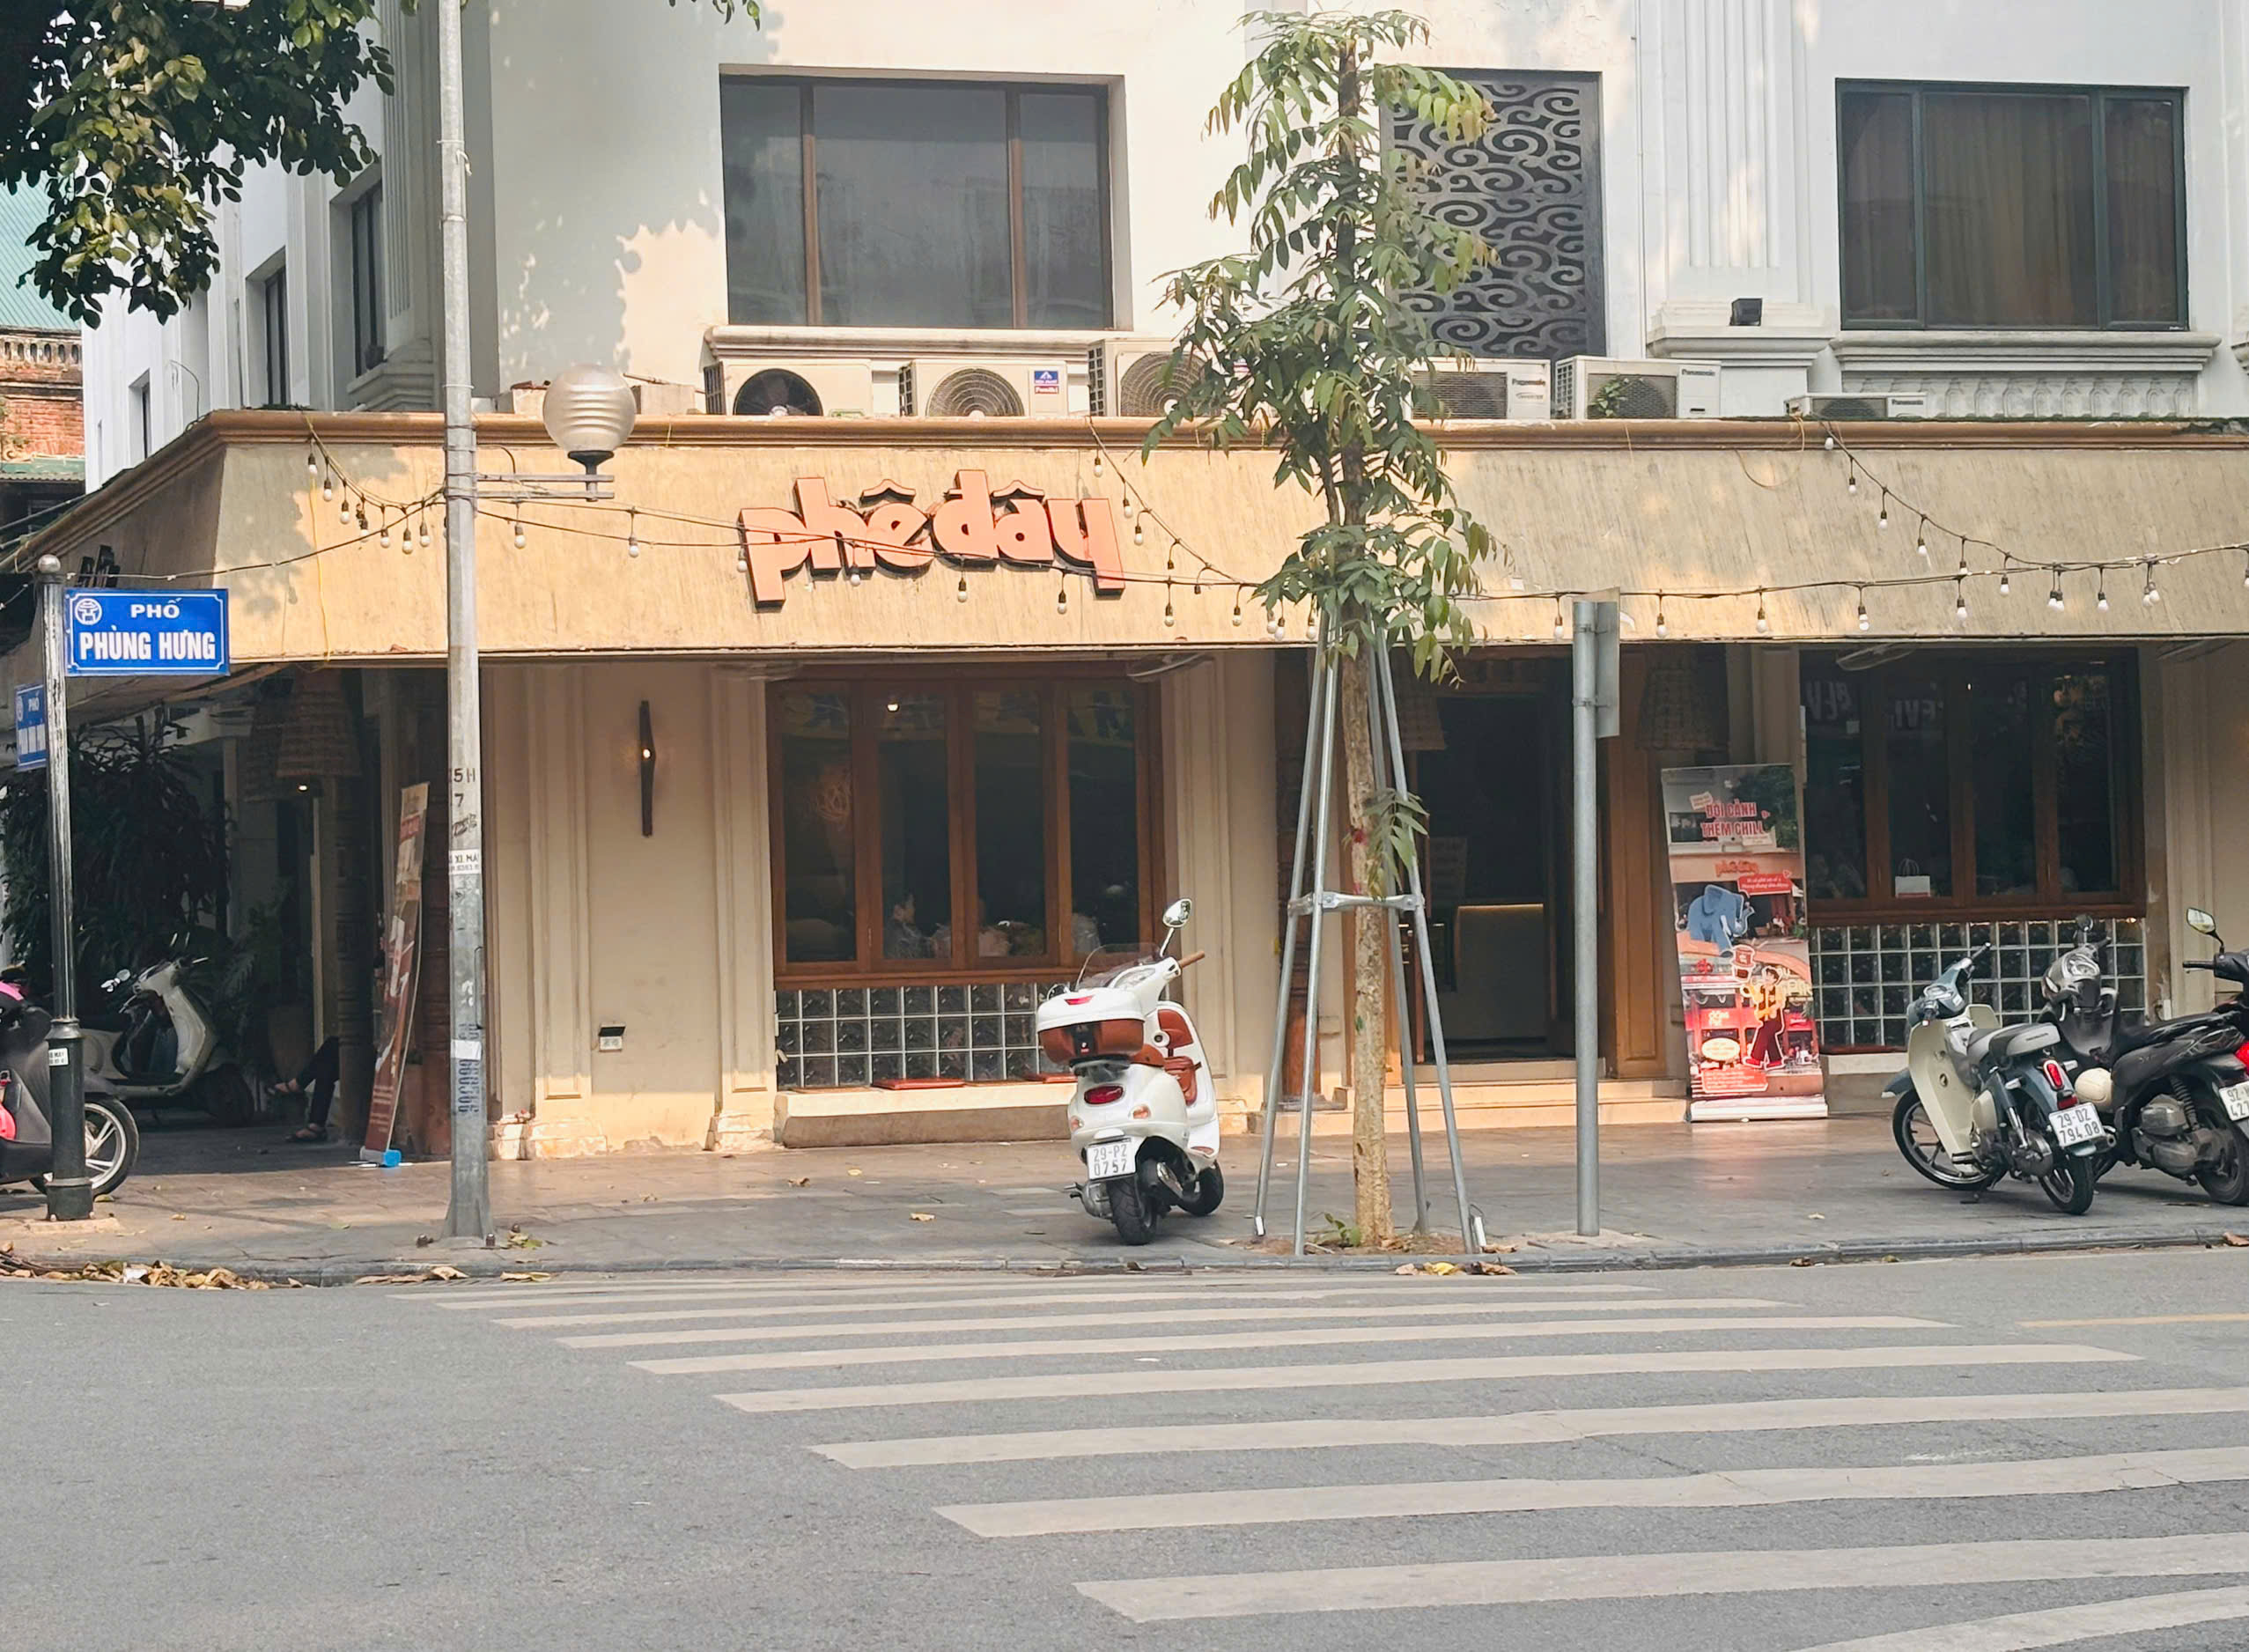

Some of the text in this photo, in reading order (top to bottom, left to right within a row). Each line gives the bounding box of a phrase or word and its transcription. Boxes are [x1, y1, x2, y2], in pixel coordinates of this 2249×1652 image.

[130, 597, 182, 618] PHỐ
[79, 624, 216, 660] PHÙNG HƯNG
[1094, 1158, 1127, 1176] 0757
